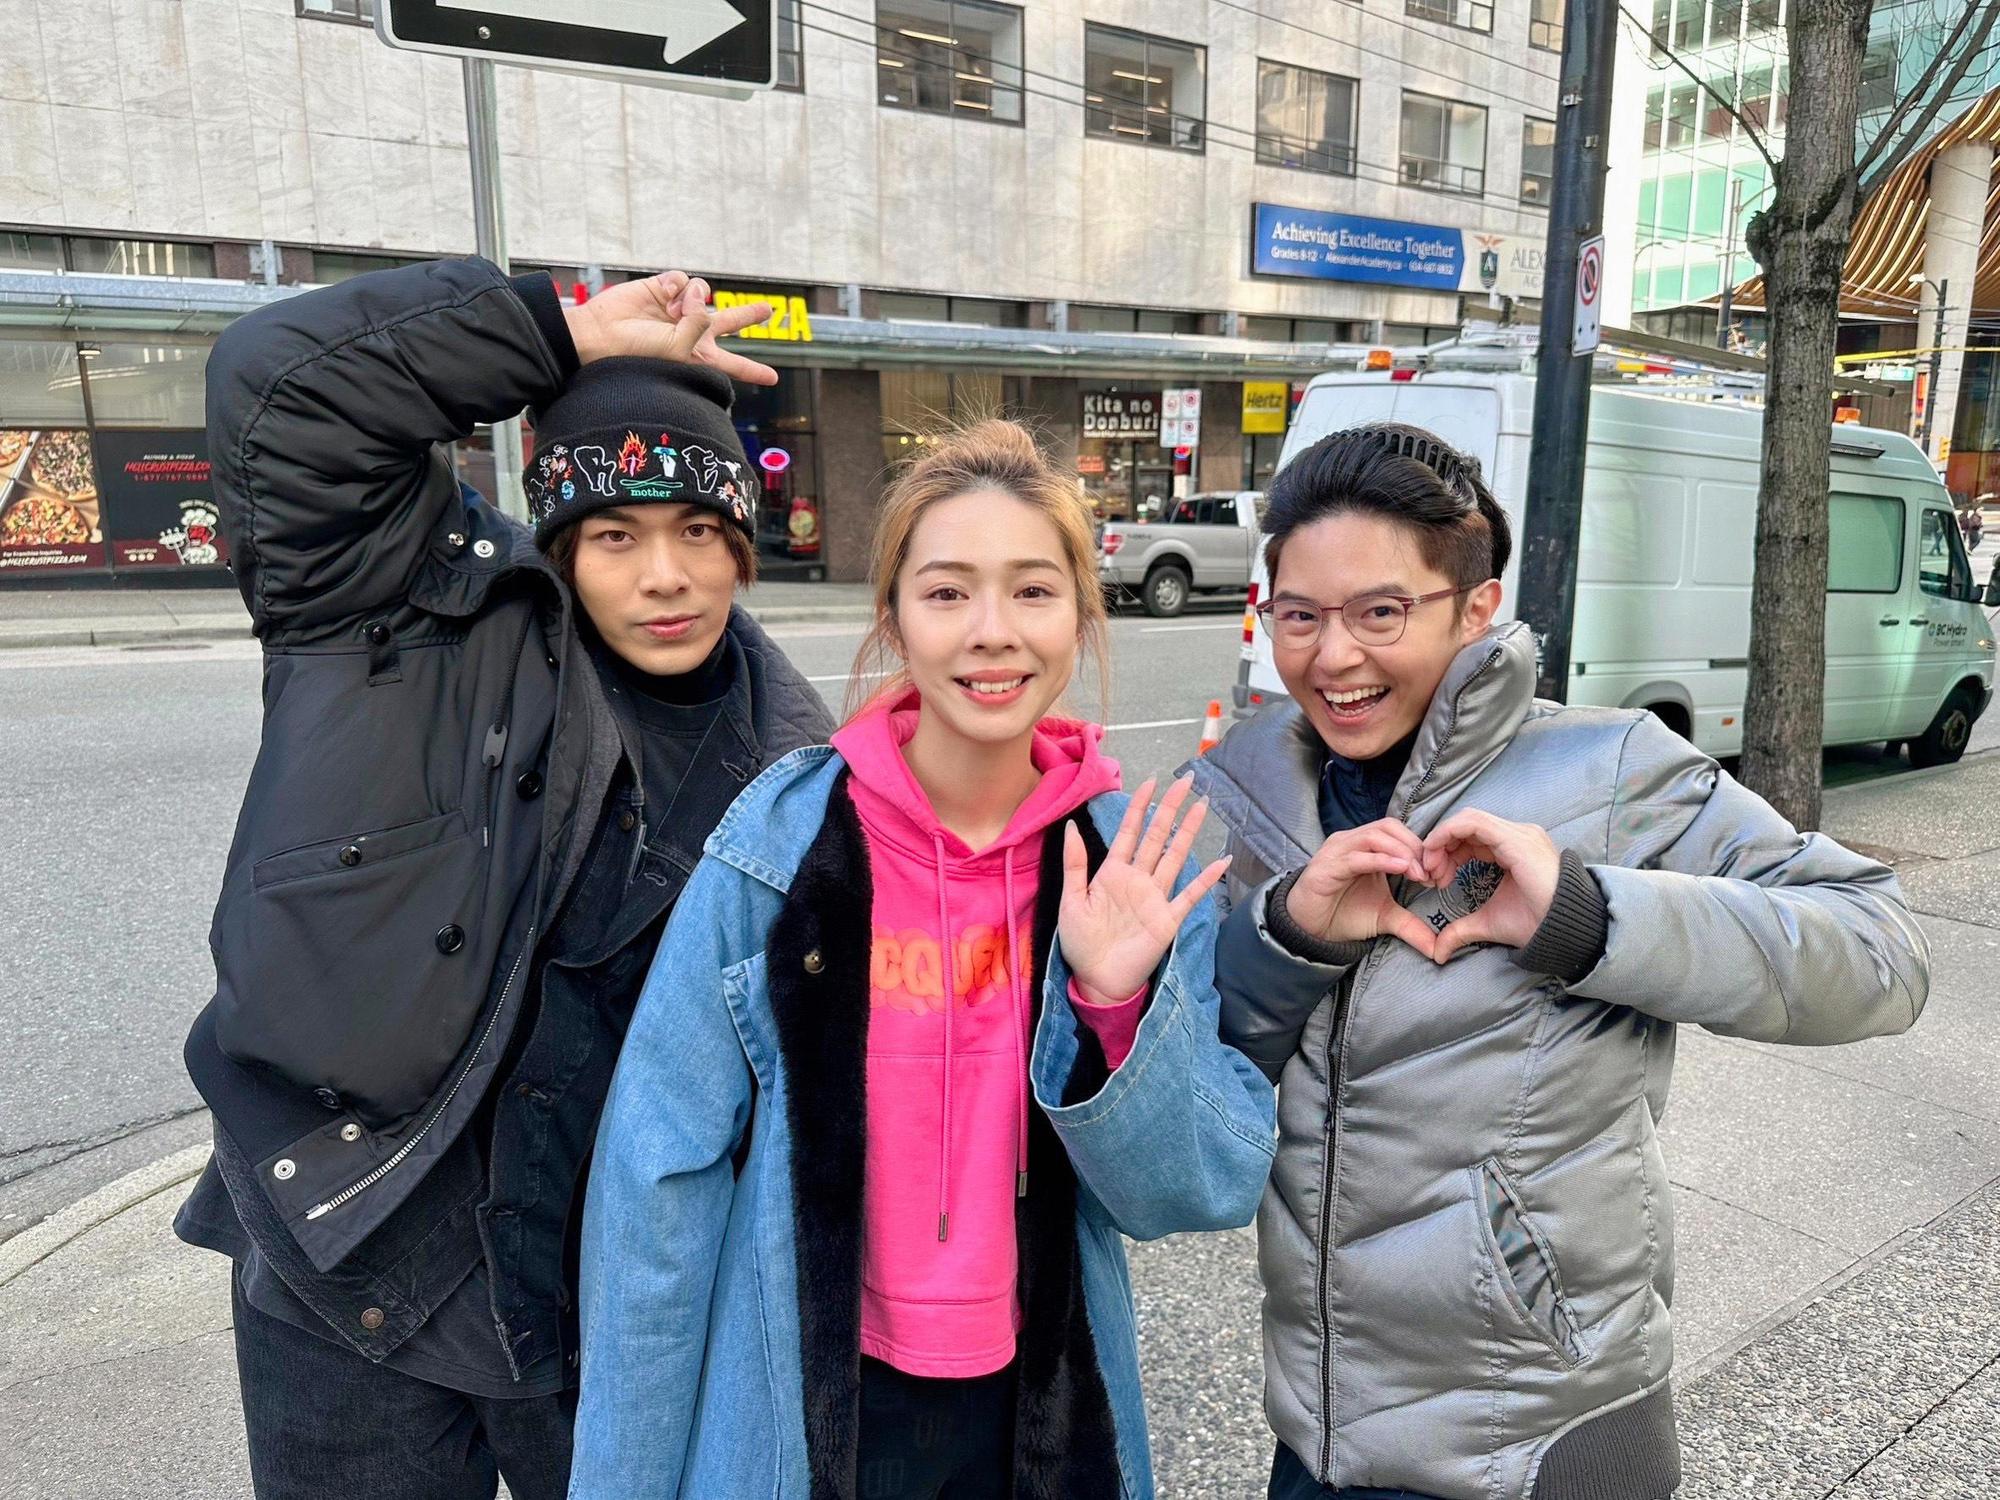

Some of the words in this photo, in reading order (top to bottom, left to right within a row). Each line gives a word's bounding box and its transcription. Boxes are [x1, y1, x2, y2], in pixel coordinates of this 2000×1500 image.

[1272, 221, 1338, 250] Achieving
[1340, 229, 1403, 254] Excellence
[1405, 237, 1455, 260] Together
[1271, 246, 1299, 261] Grades
[1084, 394, 1123, 414] Kita
[1129, 399, 1153, 414] no
[1245, 391, 1283, 408] Hertz
[1084, 412, 1159, 431] Donburi
[630, 487, 672, 498] mother
[1936, 623, 1946, 636] BC
[1947, 623, 1967, 638] Hydro
